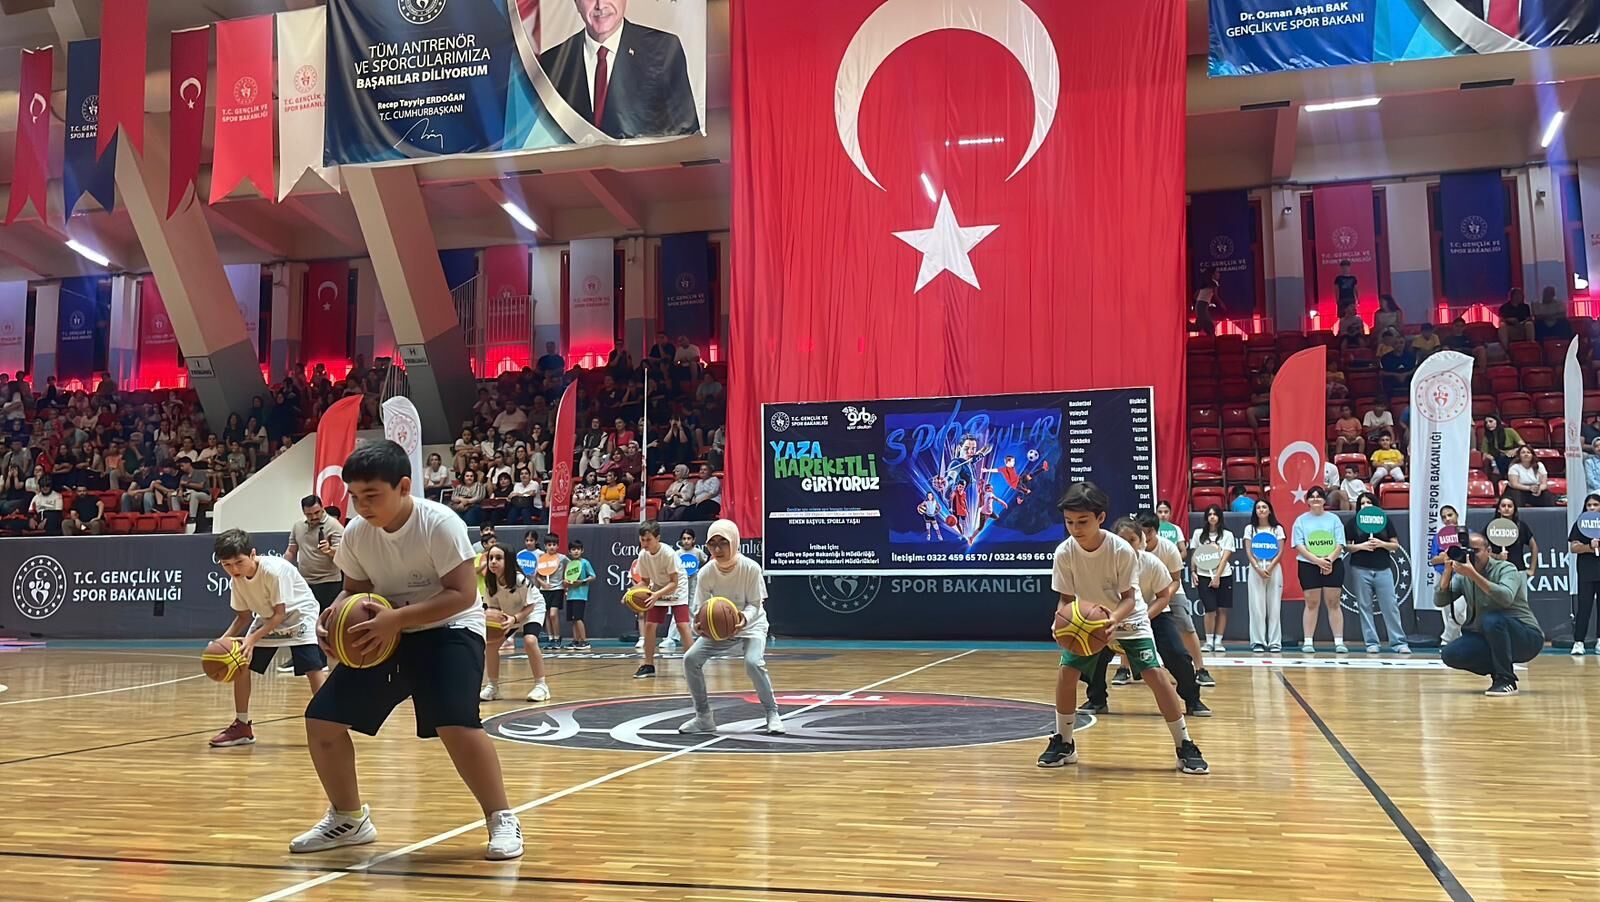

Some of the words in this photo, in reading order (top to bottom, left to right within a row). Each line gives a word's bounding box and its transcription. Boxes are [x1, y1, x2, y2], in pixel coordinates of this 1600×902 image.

[1240, 12, 1255, 21] Dr.
[1256, 8, 1293, 19] Osman
[1294, 5, 1324, 16] Aşkın
[1325, 2, 1349, 12] BAK
[1226, 22, 1272, 37] GENÇLİK
[1273, 21, 1288, 31] VE
[1289, 17, 1320, 30] SPOR
[1321, 13, 1365, 26] BAKANI
[368, 43, 398, 59] TÜM
[402, 33, 476, 55] ANTRENÖR
[354, 60, 369, 75] VE
[372, 47, 491, 73] SPORCULARIMIZA
[356, 71, 420, 90] BAŞARILAR
[421, 64, 489, 81] DİLİYORUM
[377, 101, 399, 110] Recep
[400, 97, 425, 108] Tayyip
[426, 92, 466, 104] ERDOĞAN
[379, 112, 392, 121] T.C.
[393, 103, 463, 118] CUMHURBAŞKANI
[769, 440, 823, 461] YAZA
[1430, 432, 1442, 483] BAKANLIĞI
[1430, 485, 1440, 509] SPOR
[1429, 511, 1438, 526] VE
[891, 553, 925, 563] İletişim:
[994, 553, 1015, 561] 0322
[73, 571, 97, 584] T.C.
[100, 568, 160, 587] GENÇLİK
[164, 570, 182, 583] VE
[891, 579, 938, 593] SPOR
[942, 576, 1041, 593] BAKANLIĞI
[72, 588, 107, 602] SPOR
[110, 585, 182, 602] BAKANLIĞI
